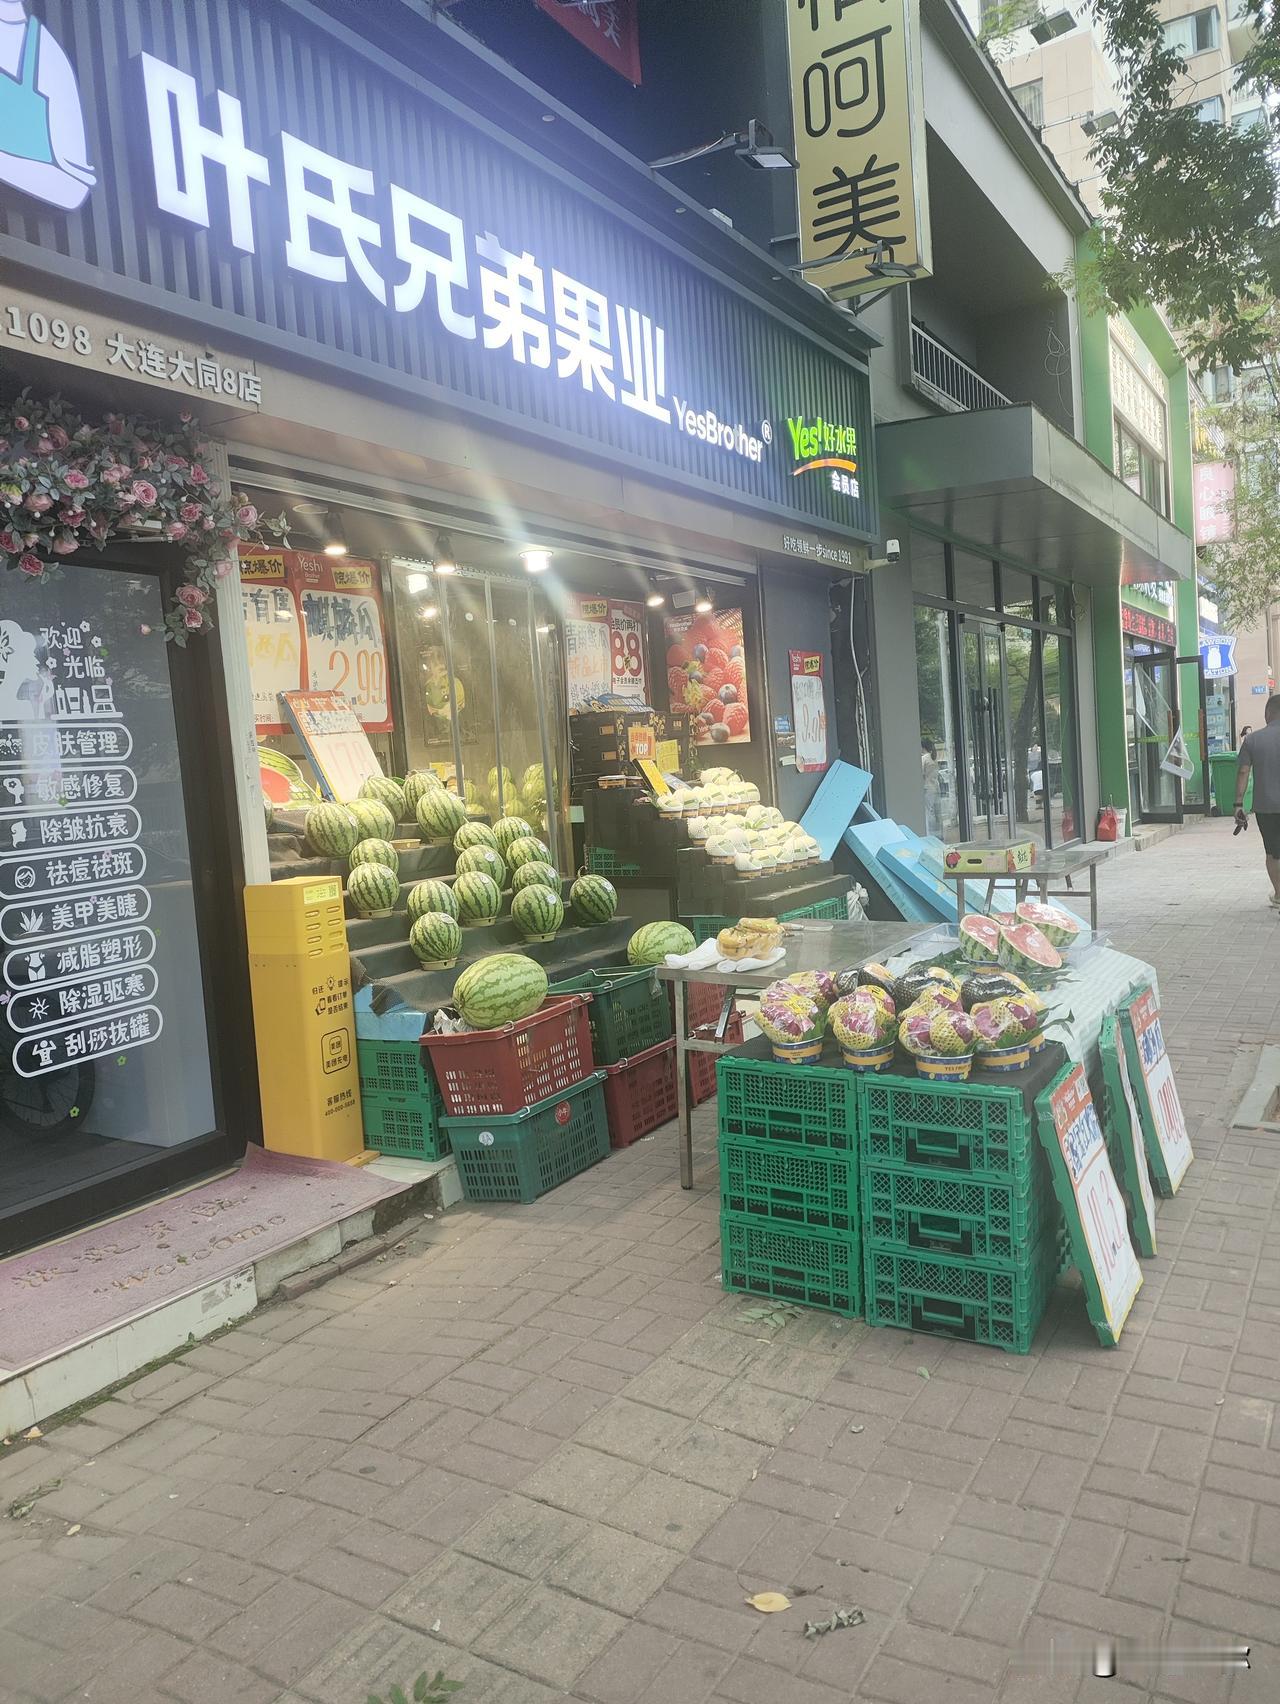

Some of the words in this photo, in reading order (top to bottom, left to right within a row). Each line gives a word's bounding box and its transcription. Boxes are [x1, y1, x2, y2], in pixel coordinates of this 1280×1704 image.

[141, 51, 672, 425] 叶氏兄弟果业
[106, 332, 262, 405] 大连大同8店
[832, 470, 860, 499] 会员店
[39, 626, 84, 650] 欢迎
[1200, 637, 1233, 649] AWSON
[62, 655, 106, 679] 光临
[1204, 665, 1233, 677] TATION
[33, 730, 120, 757] 皮肤管理
[635, 743, 649, 755] TOP
[37, 772, 125, 801] 敏感修复
[39, 812, 129, 845] 除皱抗衰
[46, 851, 134, 887] 祛痘祛斑
[51, 893, 140, 931] 美甲美睫
[56, 934, 143, 974] 减脂塑形
[58, 973, 146, 1016] 除湿驱寒
[64, 1012, 151, 1058] 刮痧拔罐
